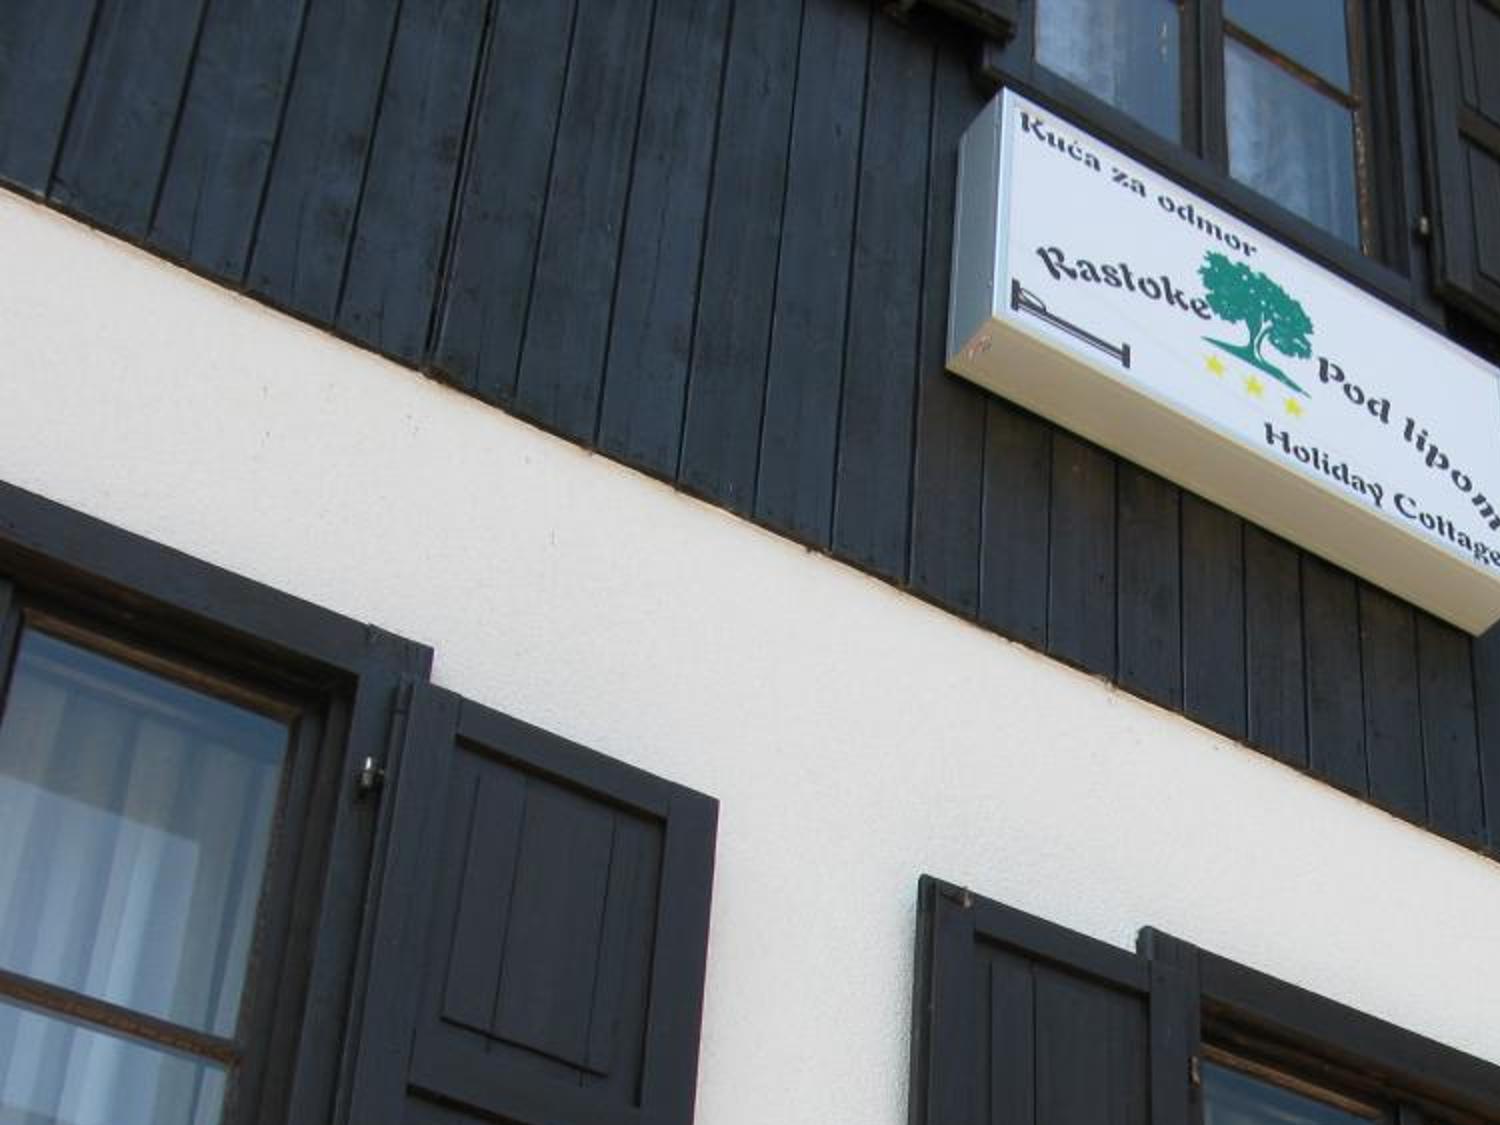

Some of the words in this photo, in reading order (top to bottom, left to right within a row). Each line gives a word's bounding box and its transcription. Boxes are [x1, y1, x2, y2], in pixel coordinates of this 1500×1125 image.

[1021, 112, 1101, 172] Kuća
[1112, 168, 1147, 197] za
[1158, 194, 1257, 256] odmor
[1036, 246, 1212, 320] Rastoke
[1317, 357, 1391, 424] Pod
[1265, 423, 1383, 507] Holiday
